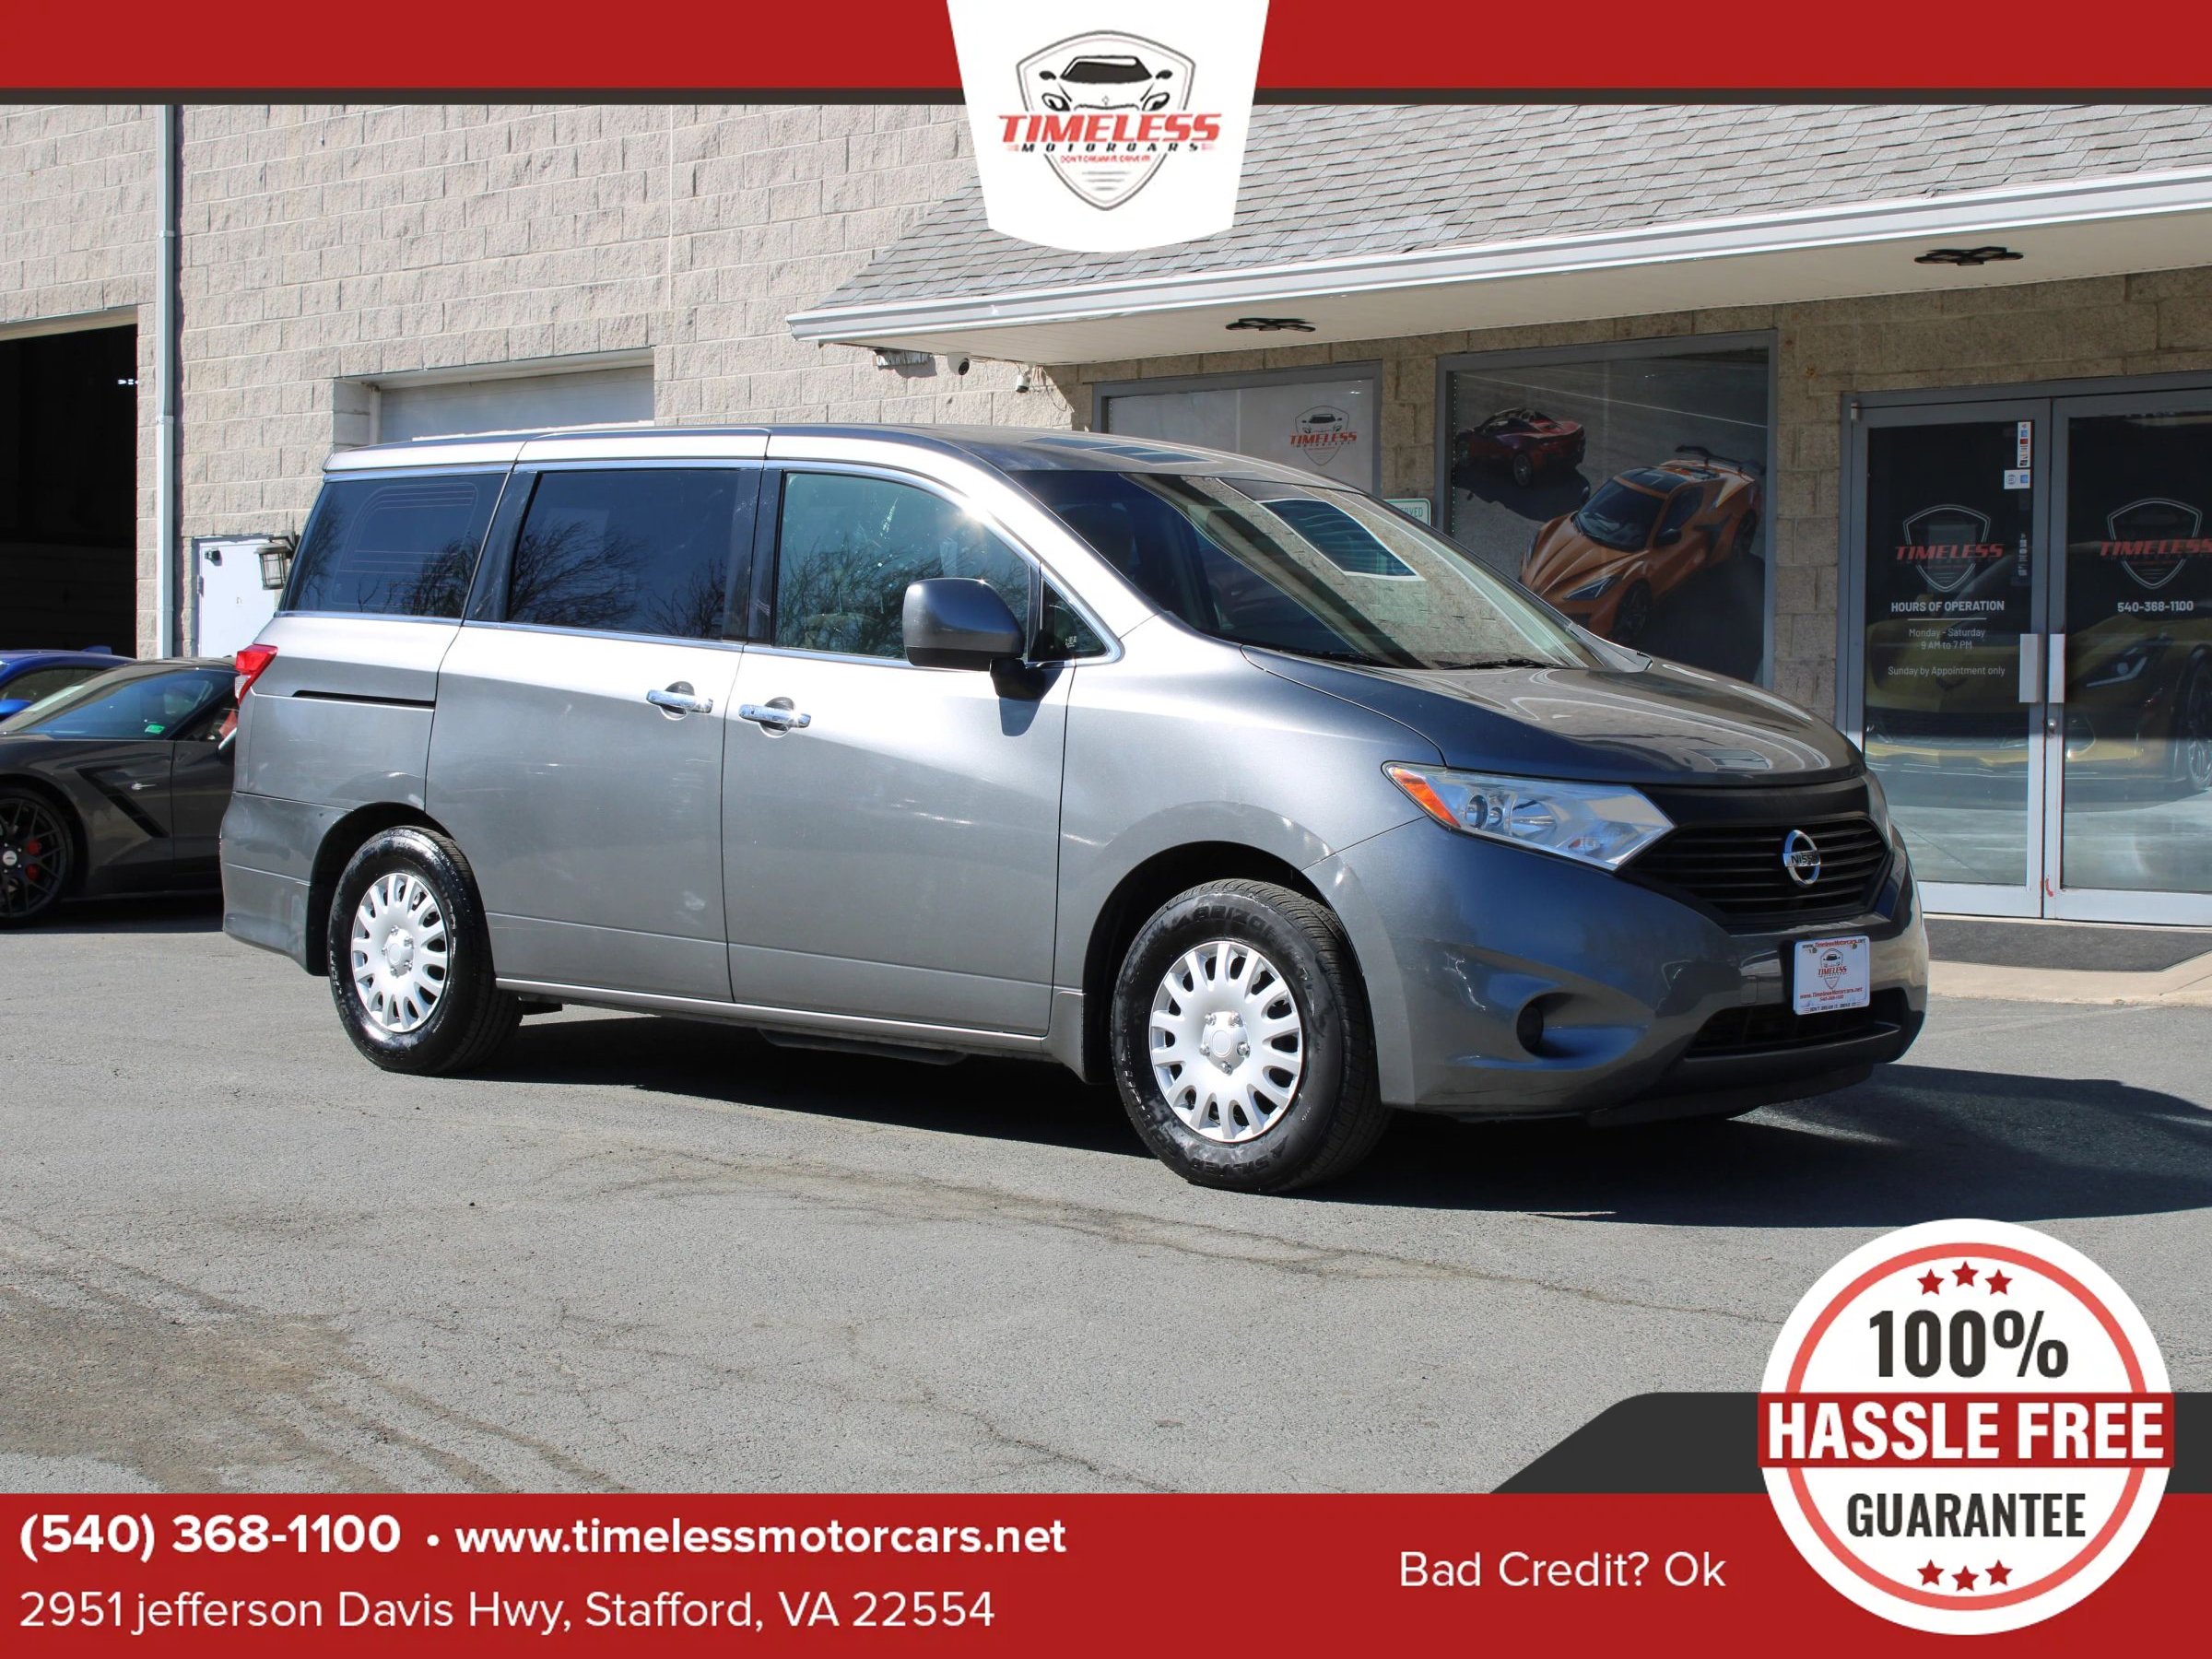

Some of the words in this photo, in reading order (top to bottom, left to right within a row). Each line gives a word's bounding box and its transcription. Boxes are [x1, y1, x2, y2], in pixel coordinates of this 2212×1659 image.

[1290, 431, 1358, 445] TIMELESS
[1895, 543, 2006, 560] TIMELESS
[2099, 538, 2212, 557] TIMELESS
[1890, 601, 1926, 612] HOURS
[1928, 601, 1943, 611] OF
[1944, 600, 2005, 611] OPERATION
[2117, 600, 2194, 613] 540-368-1100
[1909, 628, 1941, 639] Monday
[1947, 628, 1986, 638] Saturday
[1921, 641, 1926, 650] 9
[1928, 641, 1941, 649] AM
[1942, 641, 1952, 649] to
[1953, 641, 1958, 649] 7
[1959, 641, 1972, 649] PM
[1888, 665, 1918, 677] Sunday
[1920, 666, 1930, 677] by
[1931, 666, 1986, 677] Appointment
[1987, 665, 2006, 677] only
